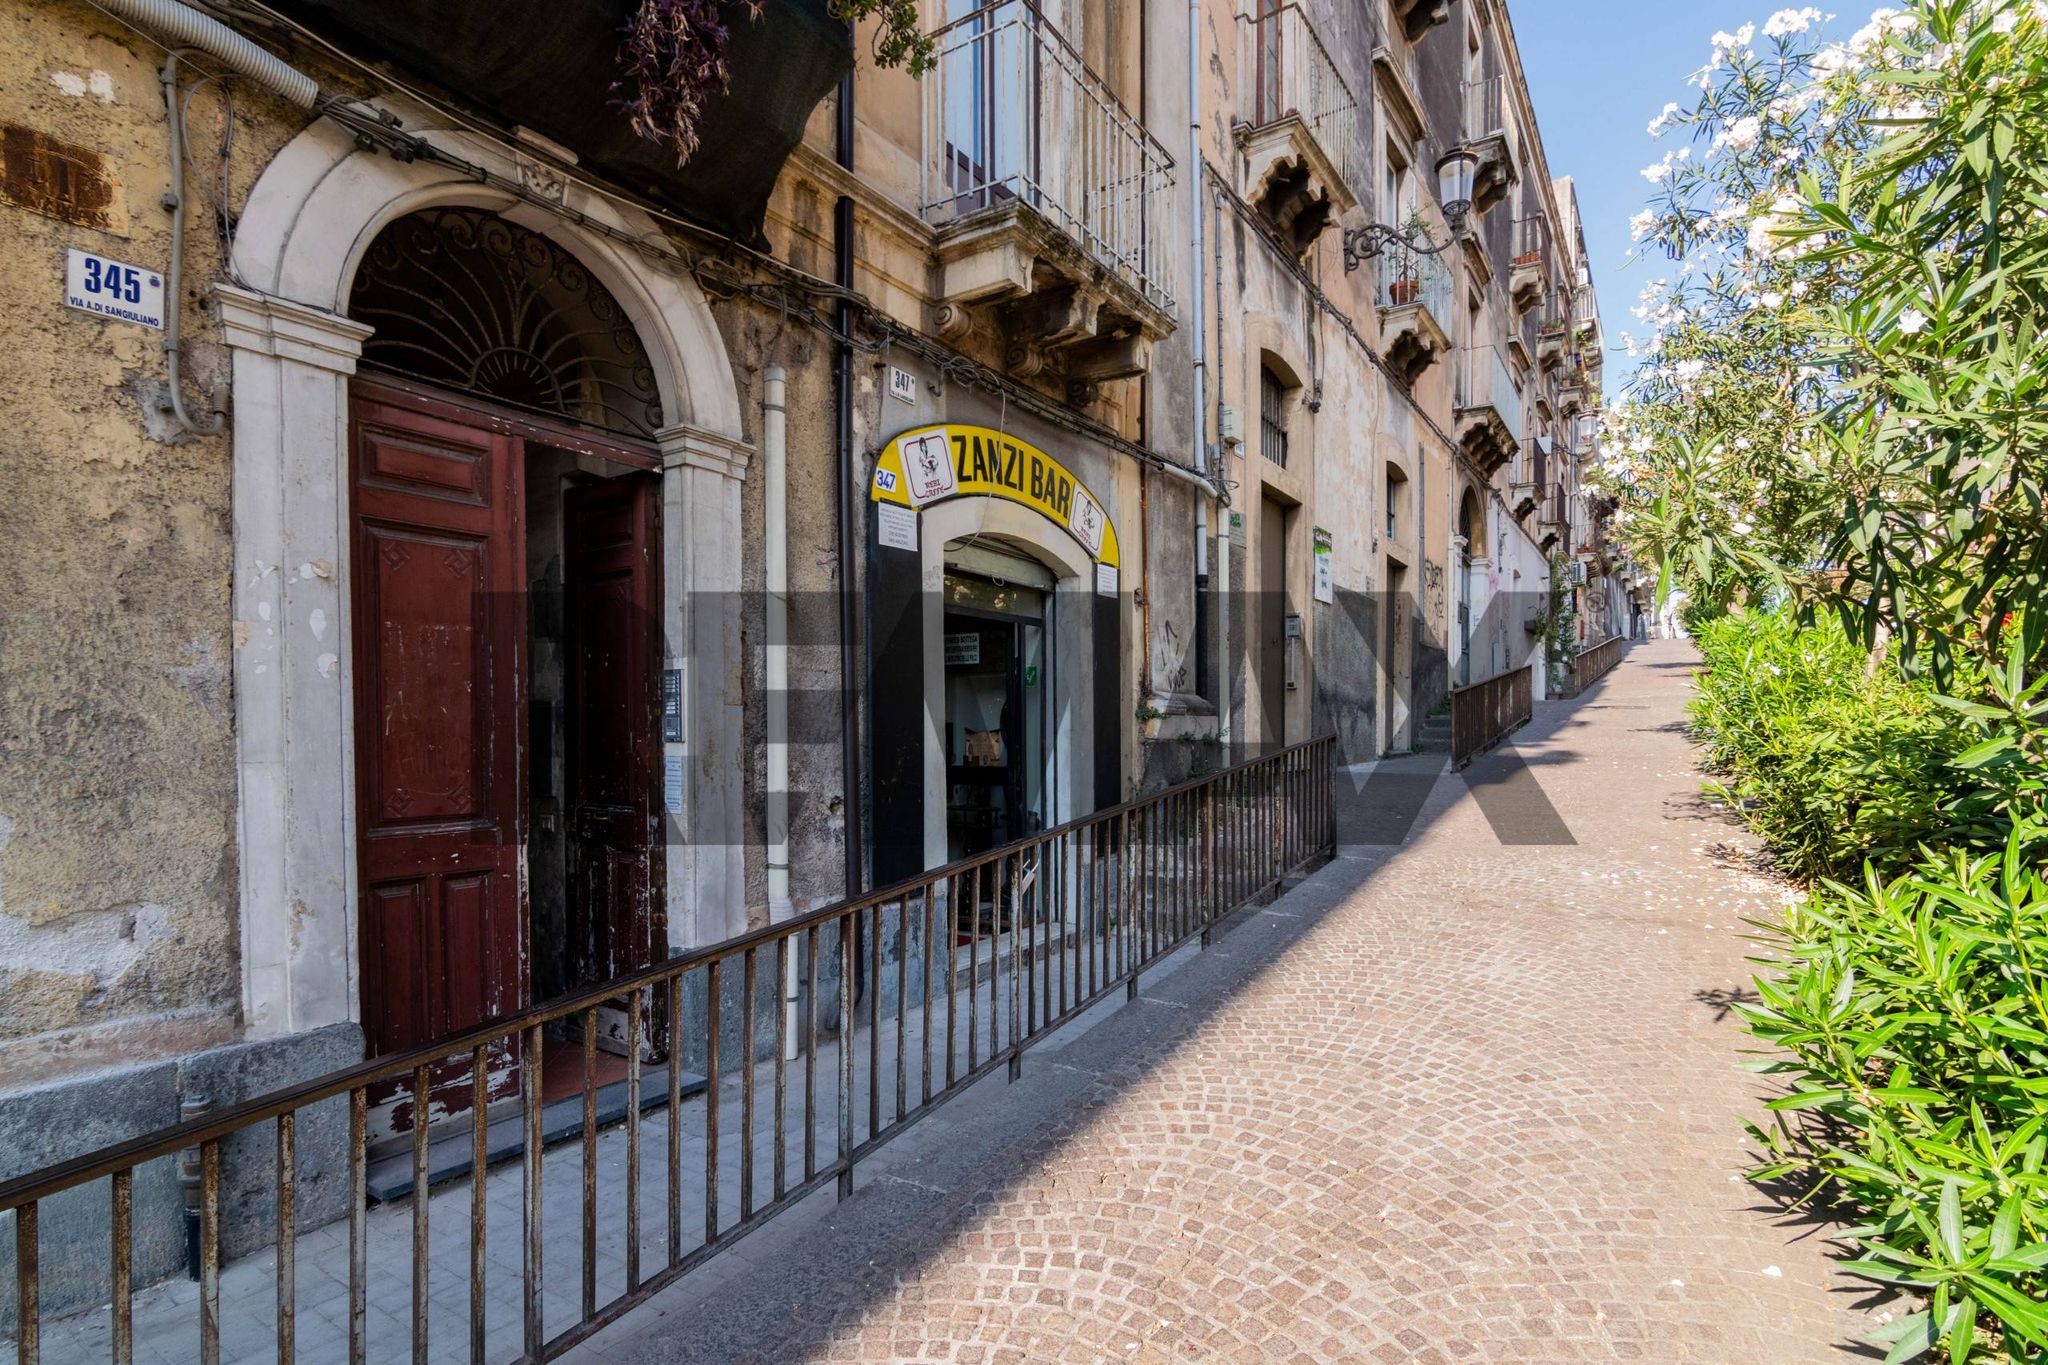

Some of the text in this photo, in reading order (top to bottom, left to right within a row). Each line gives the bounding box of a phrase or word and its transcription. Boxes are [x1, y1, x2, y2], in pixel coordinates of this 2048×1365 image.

[84, 257, 141, 304] 345
[70, 296, 159, 327] VIA A.DI SANGIULIANO
[895, 370, 910, 392] 347
[876, 470, 896, 489] 347
[951, 435, 1071, 519] ZANZI BAR
